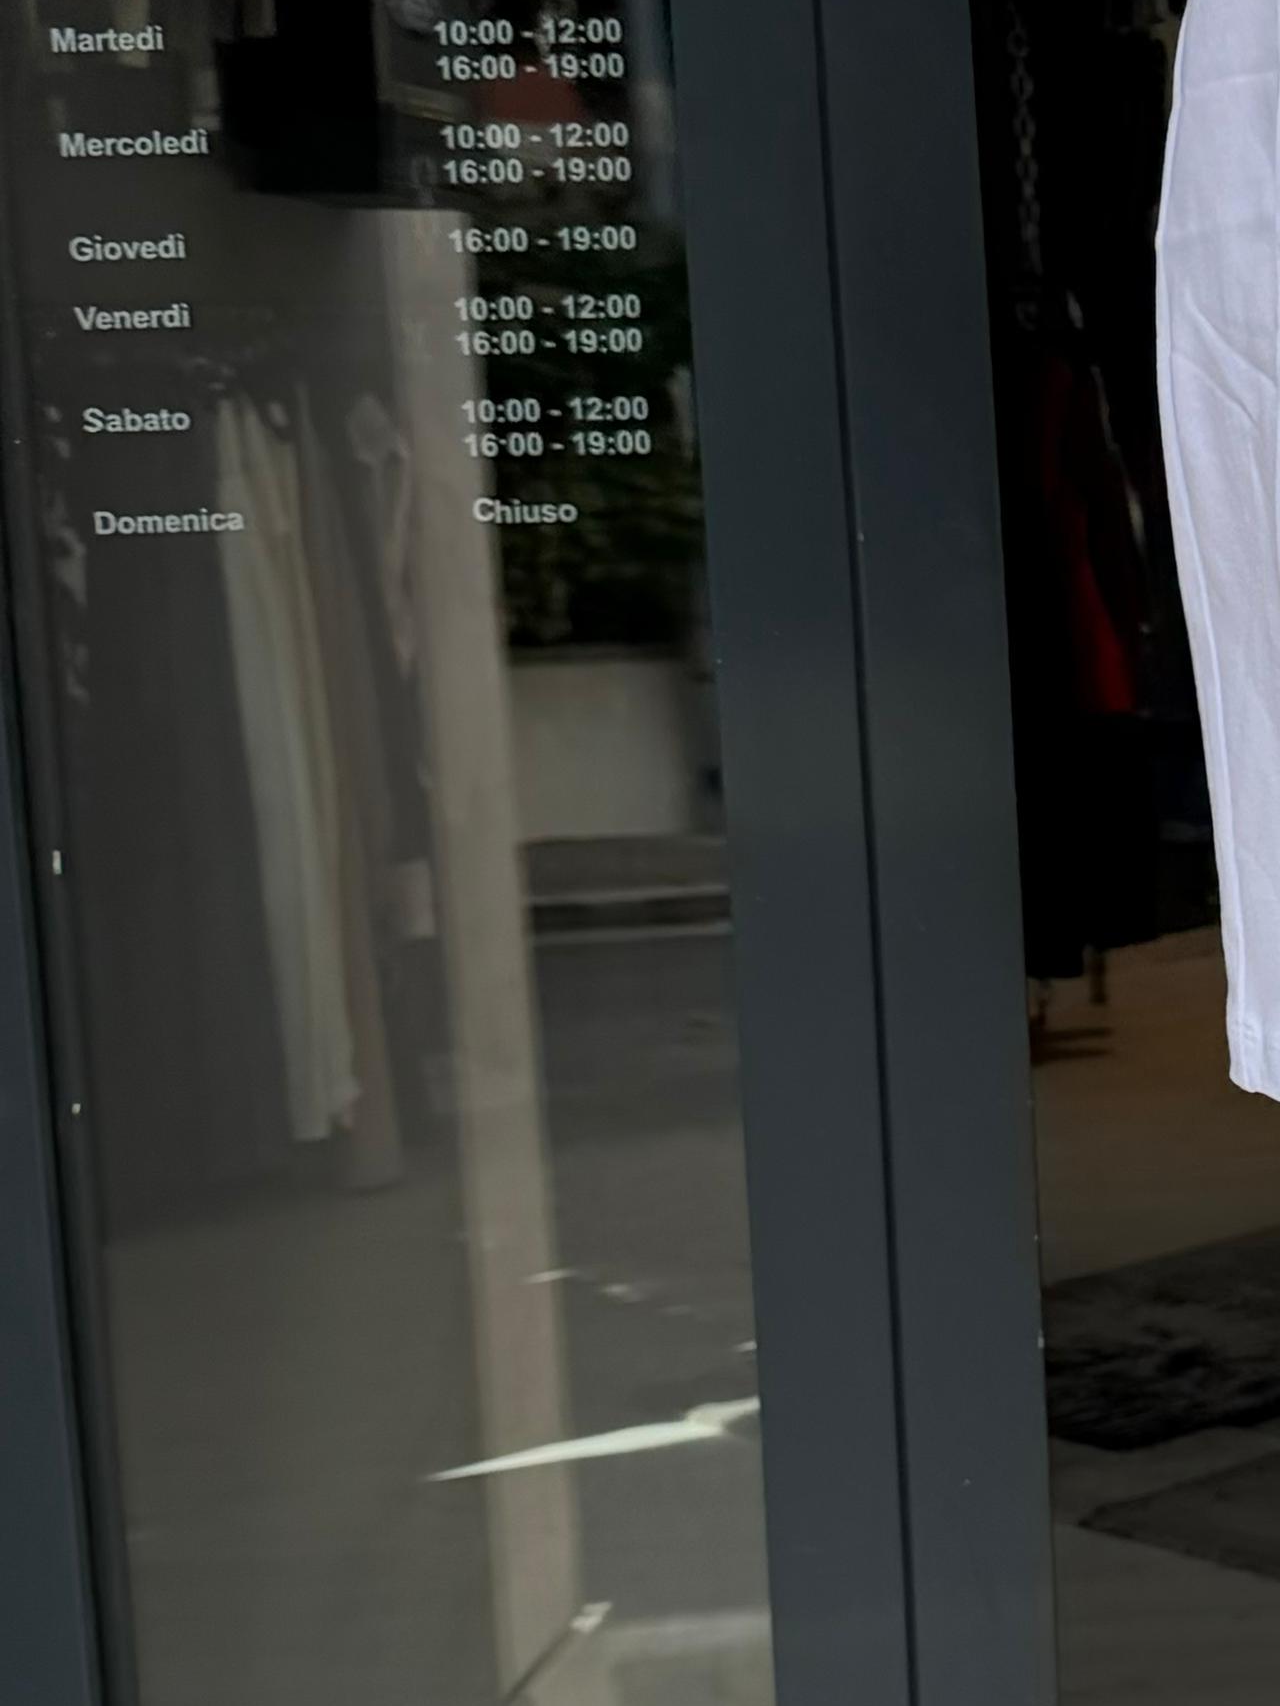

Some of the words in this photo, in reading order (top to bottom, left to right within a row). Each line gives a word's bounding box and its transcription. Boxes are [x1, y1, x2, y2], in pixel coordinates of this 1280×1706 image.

[50, 25, 165, 53] Martedì
[434, 20, 515, 46] 10:00
[543, 18, 623, 44] 12:00
[436, 55, 517, 81] 16:00
[544, 53, 625, 79] 19:00
[59, 128, 209, 158] Mercoledì
[440, 124, 522, 150] 10:00
[549, 122, 630, 148] 12:00
[443, 159, 524, 185] 16:00
[552, 157, 632, 182] 19:00
[68, 234, 187, 262] Giovedì
[449, 227, 530, 253] 16:00
[558, 225, 637, 251] 19:00
[73, 303, 191, 330] Venerdì
[454, 296, 534, 321] 10:00
[562, 294, 642, 319] 12:00
[456, 330, 537, 355] 16:00
[564, 328, 643, 353] 19:00
[82, 407, 191, 433] Sabato
[461, 398, 542, 423] 10:00
[569, 396, 649, 421] 12:00
[464, 432, 544, 457] 16:00
[571, 430, 651, 455] 19:00
[93, 508, 245, 535] Domenica
[472, 496, 578, 524] Chiuso
